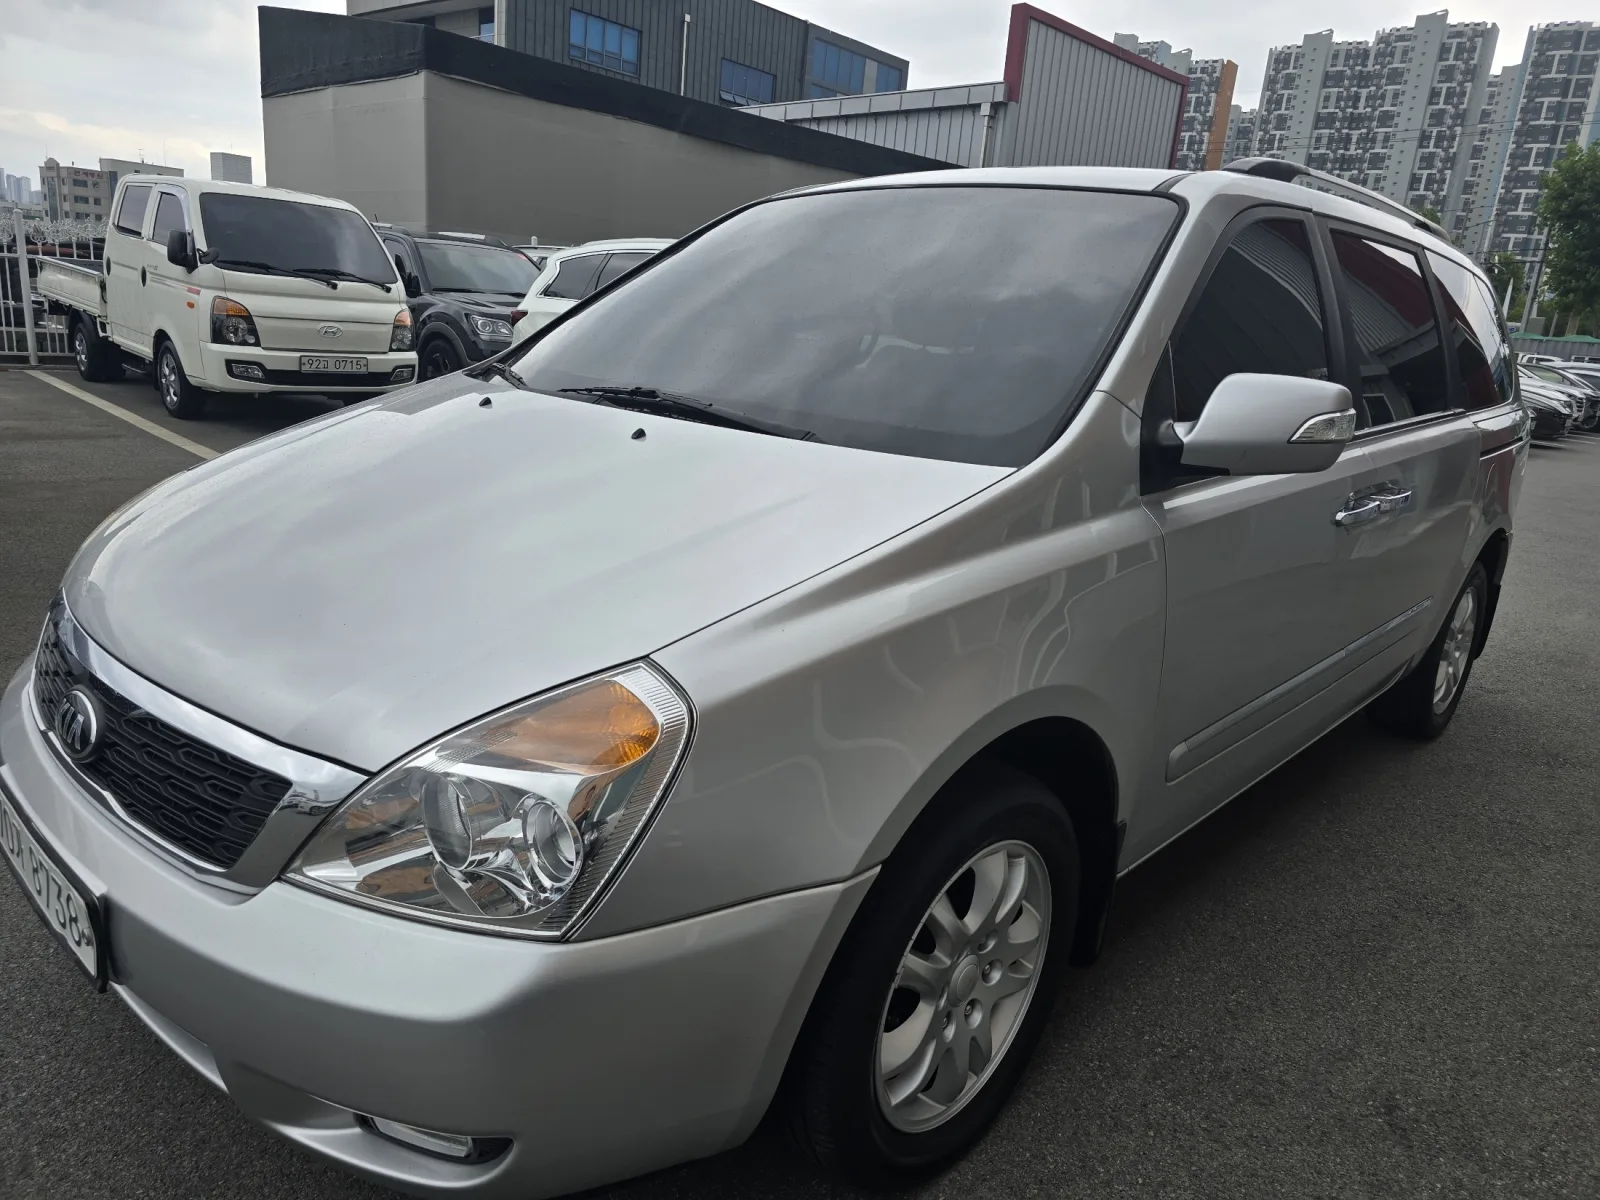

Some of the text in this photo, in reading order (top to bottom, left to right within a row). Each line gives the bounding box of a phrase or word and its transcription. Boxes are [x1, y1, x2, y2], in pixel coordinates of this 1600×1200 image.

[307, 358, 362, 371] 92고 0715
[57, 697, 85, 751] KIA
[29, 845, 82, 948] 8738
